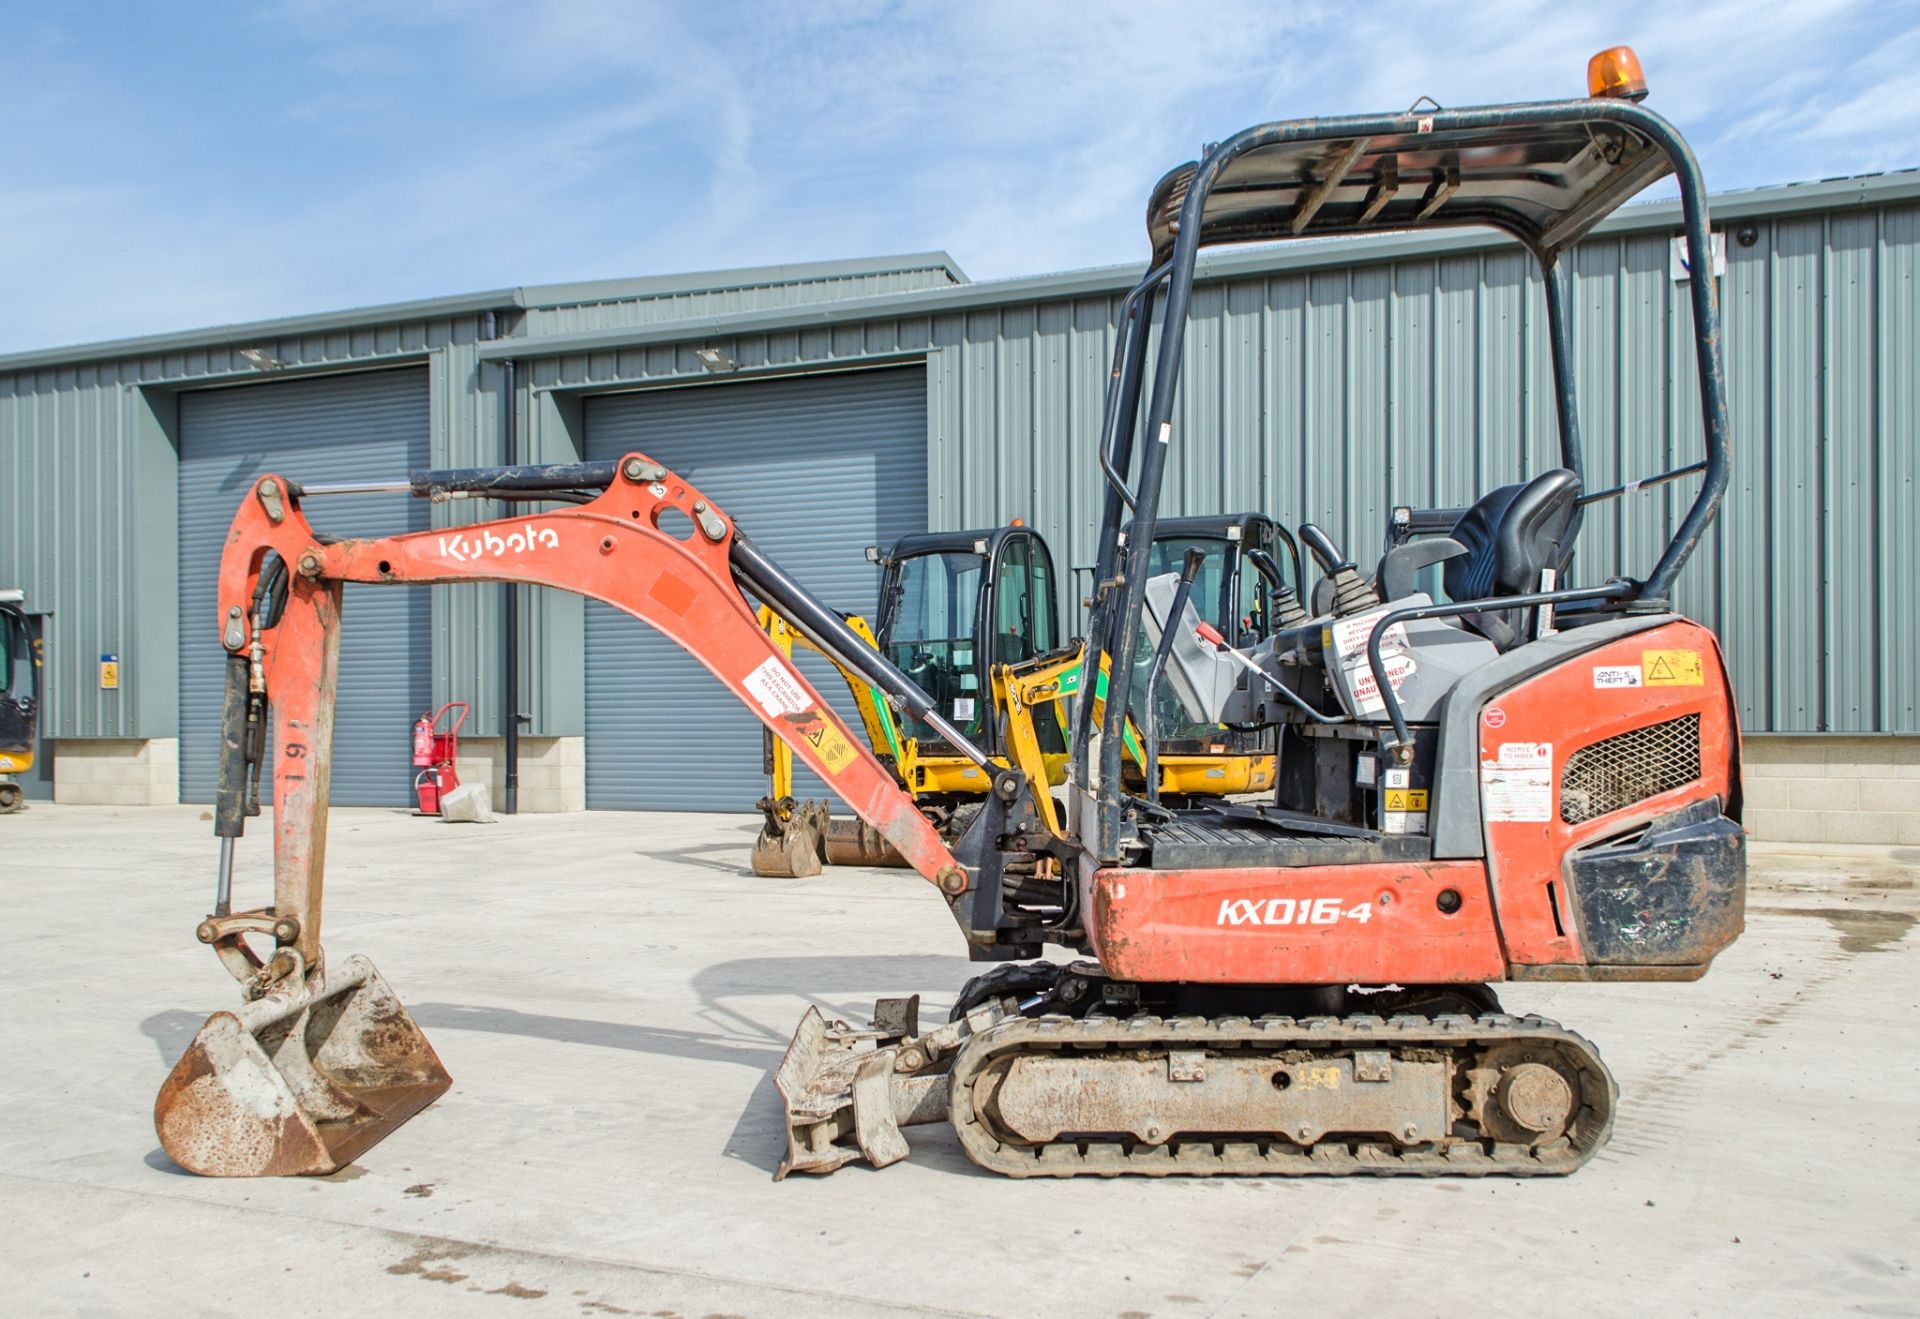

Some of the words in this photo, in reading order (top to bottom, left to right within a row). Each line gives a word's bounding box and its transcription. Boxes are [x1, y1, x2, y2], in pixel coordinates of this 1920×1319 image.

[439, 524, 559, 561] Kubota
[761, 667, 773, 680] THIS
[772, 680, 801, 712] EXCAVATOR
[771, 667, 780, 677] DO
[780, 677, 791, 689] NOT
[791, 689, 801, 701] USE
